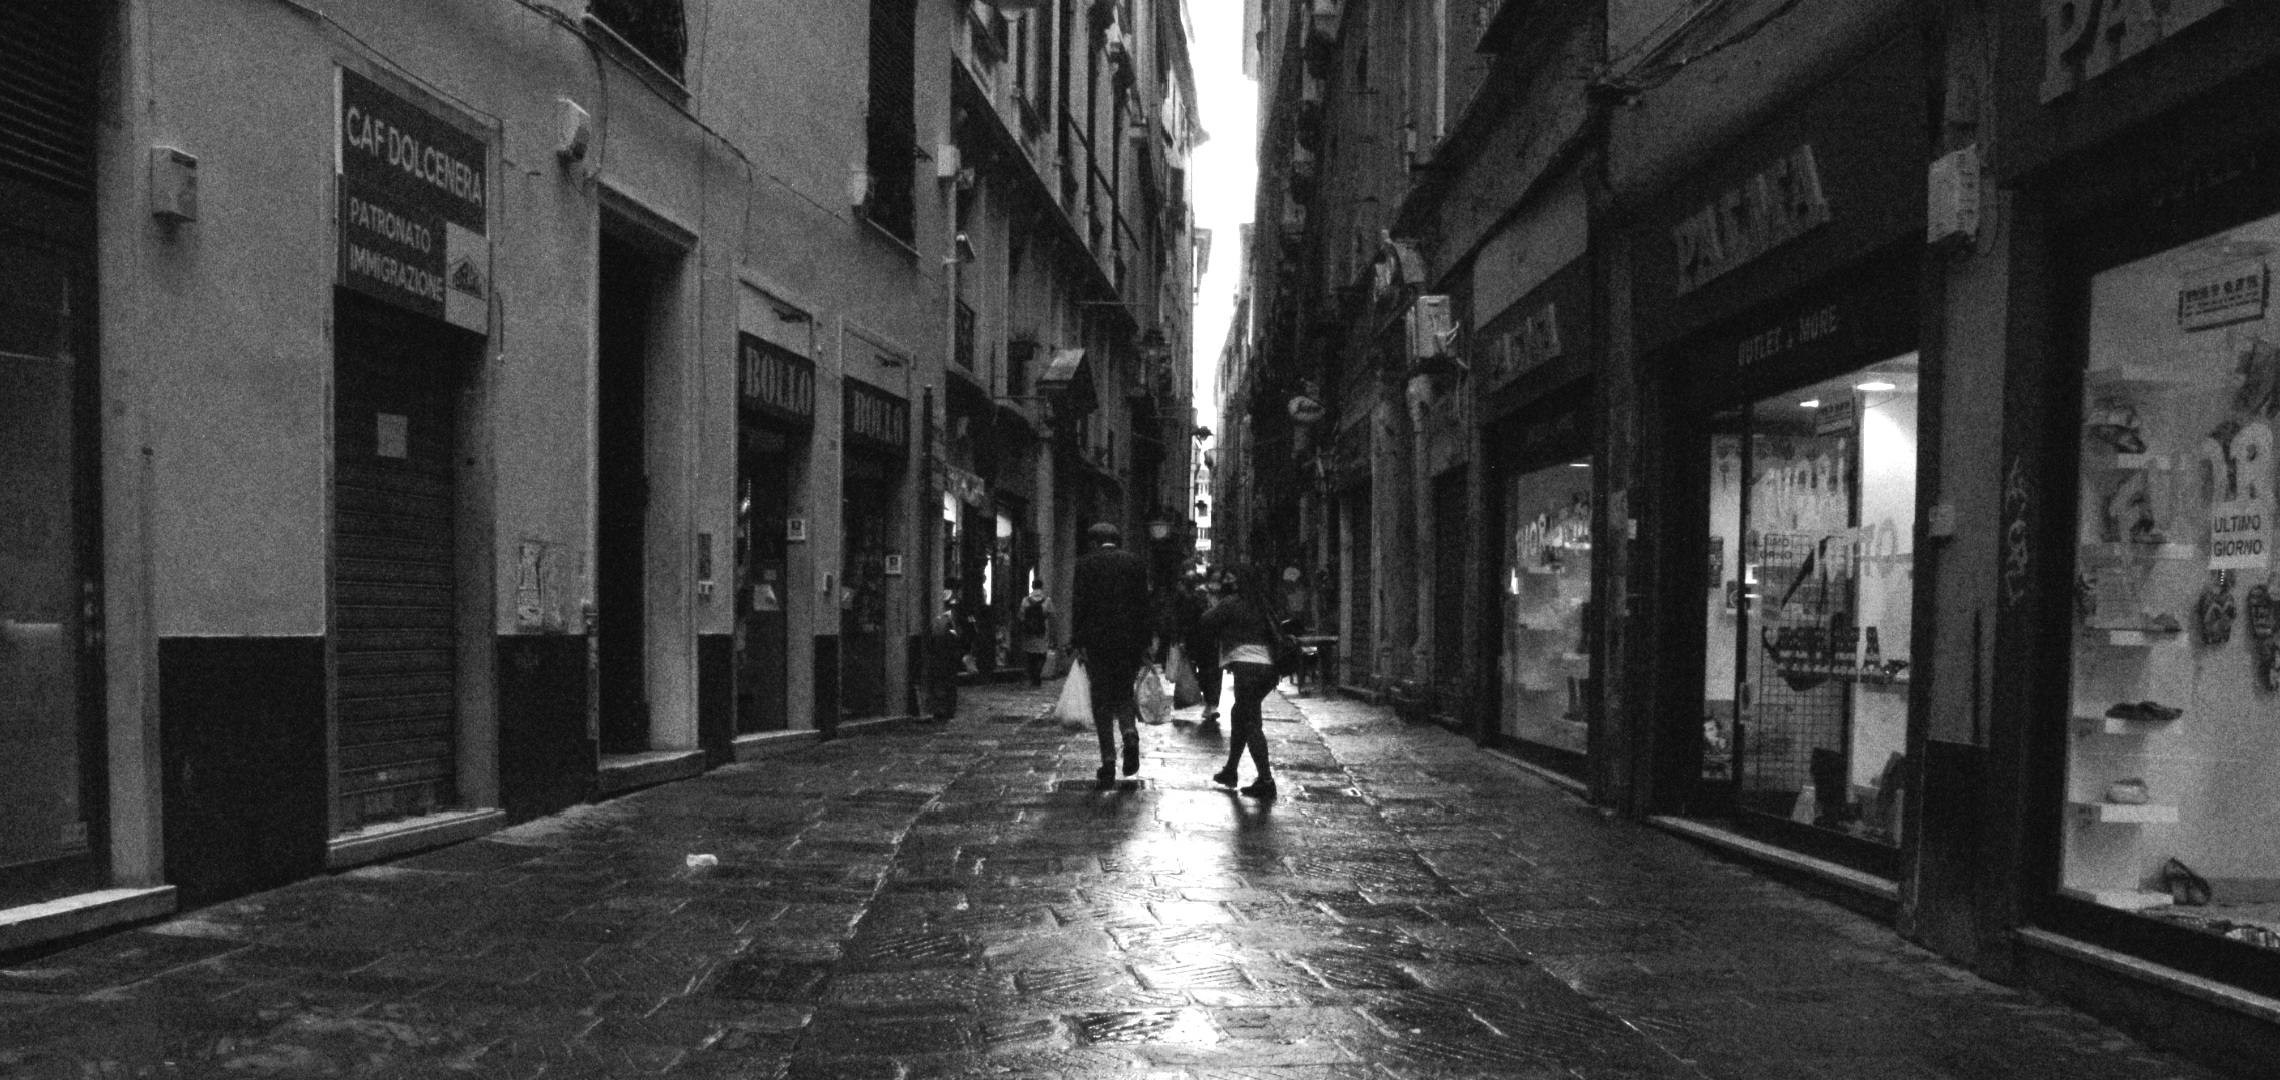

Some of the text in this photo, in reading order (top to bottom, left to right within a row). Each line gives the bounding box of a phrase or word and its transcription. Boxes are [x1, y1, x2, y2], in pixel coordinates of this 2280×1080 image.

[347, 106, 482, 207] CAF DOLCENERA
[350, 196, 431, 254] PATRONATO
[349, 242, 444, 302] IMMIGRAZIONE
[1799, 304, 1837, 344] MORE
[745, 345, 812, 415] BOLLO
[854, 390, 904, 446] BOLLO
[2213, 514, 2261, 533] ULTIMO
[2213, 539, 2263, 557] GIORNO
